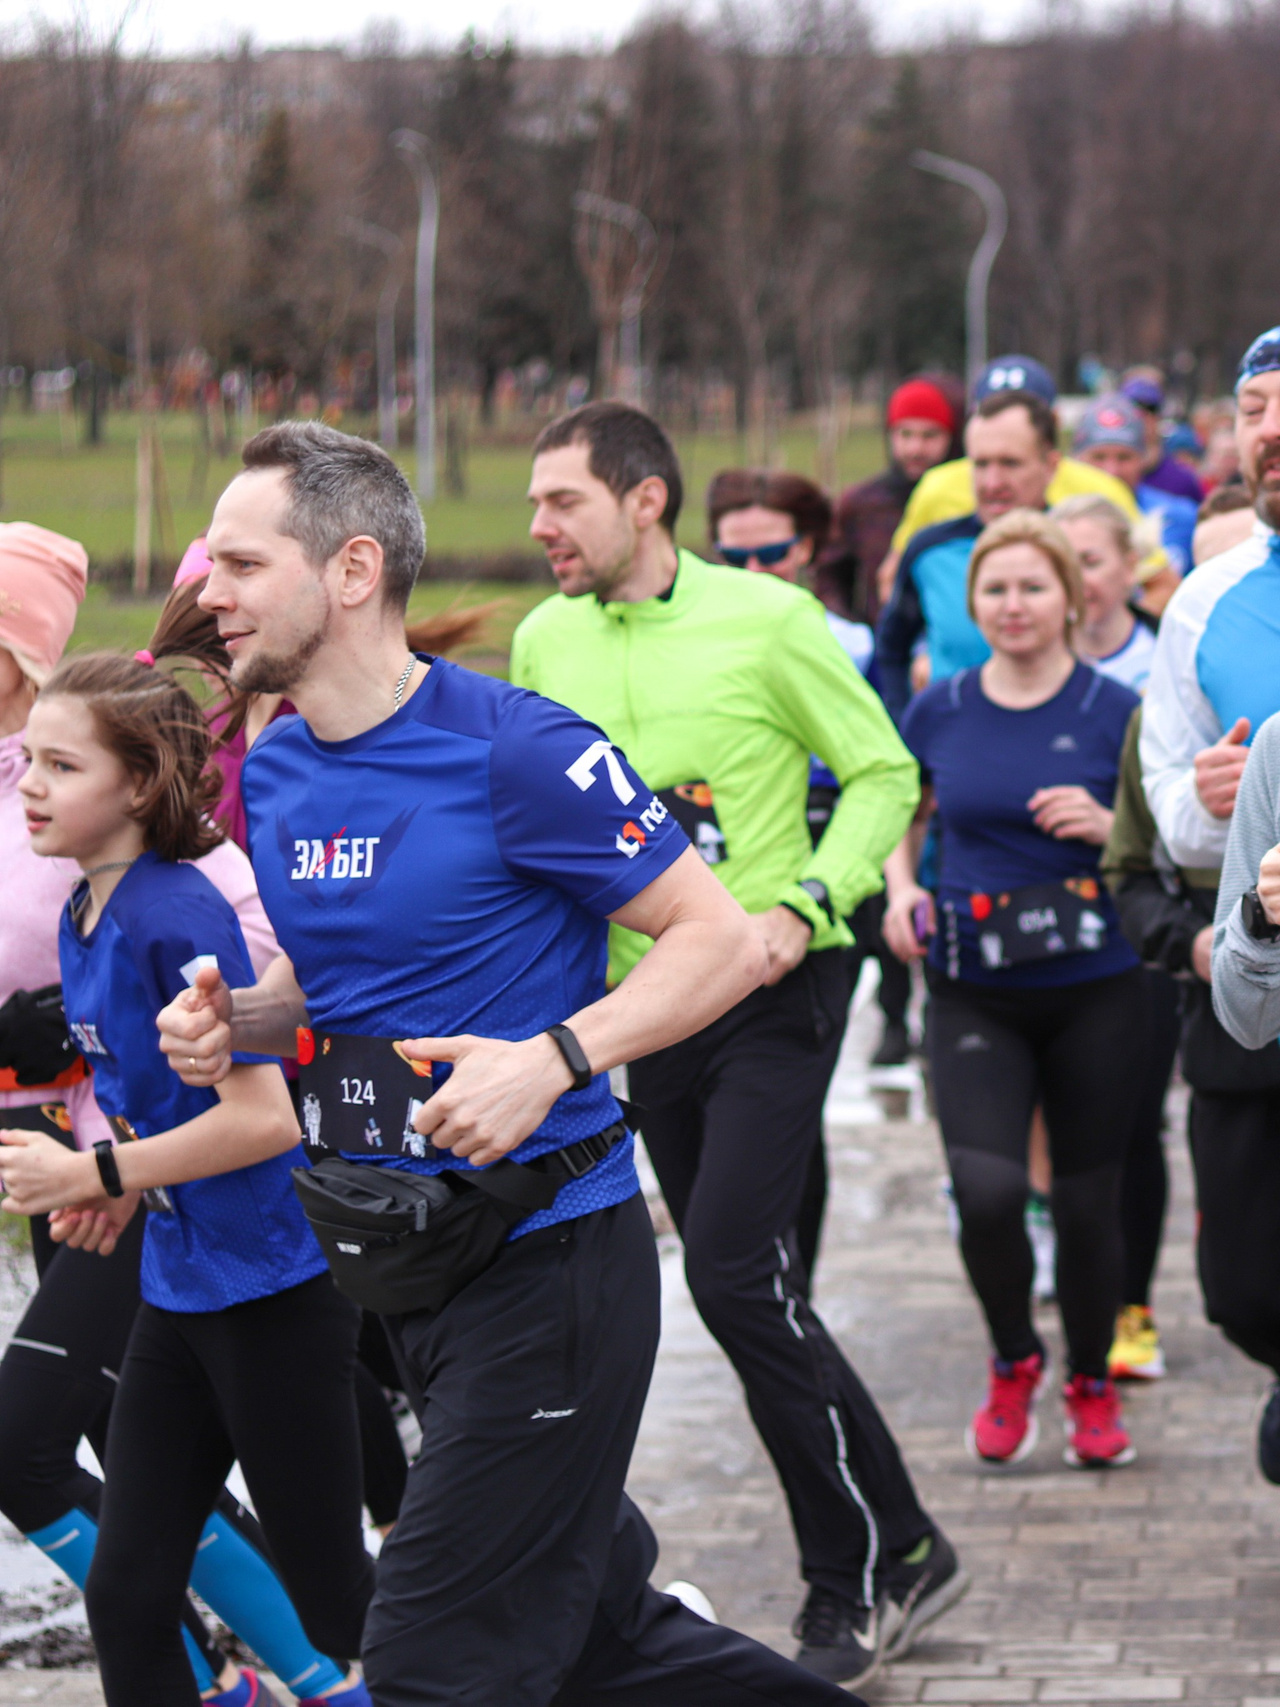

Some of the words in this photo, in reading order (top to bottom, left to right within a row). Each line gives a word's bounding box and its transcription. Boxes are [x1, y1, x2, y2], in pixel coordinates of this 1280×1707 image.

[564, 740, 637, 806] 7
[291, 837, 380, 880] ЗАБЕГ
[340, 1077, 376, 1106] 124
